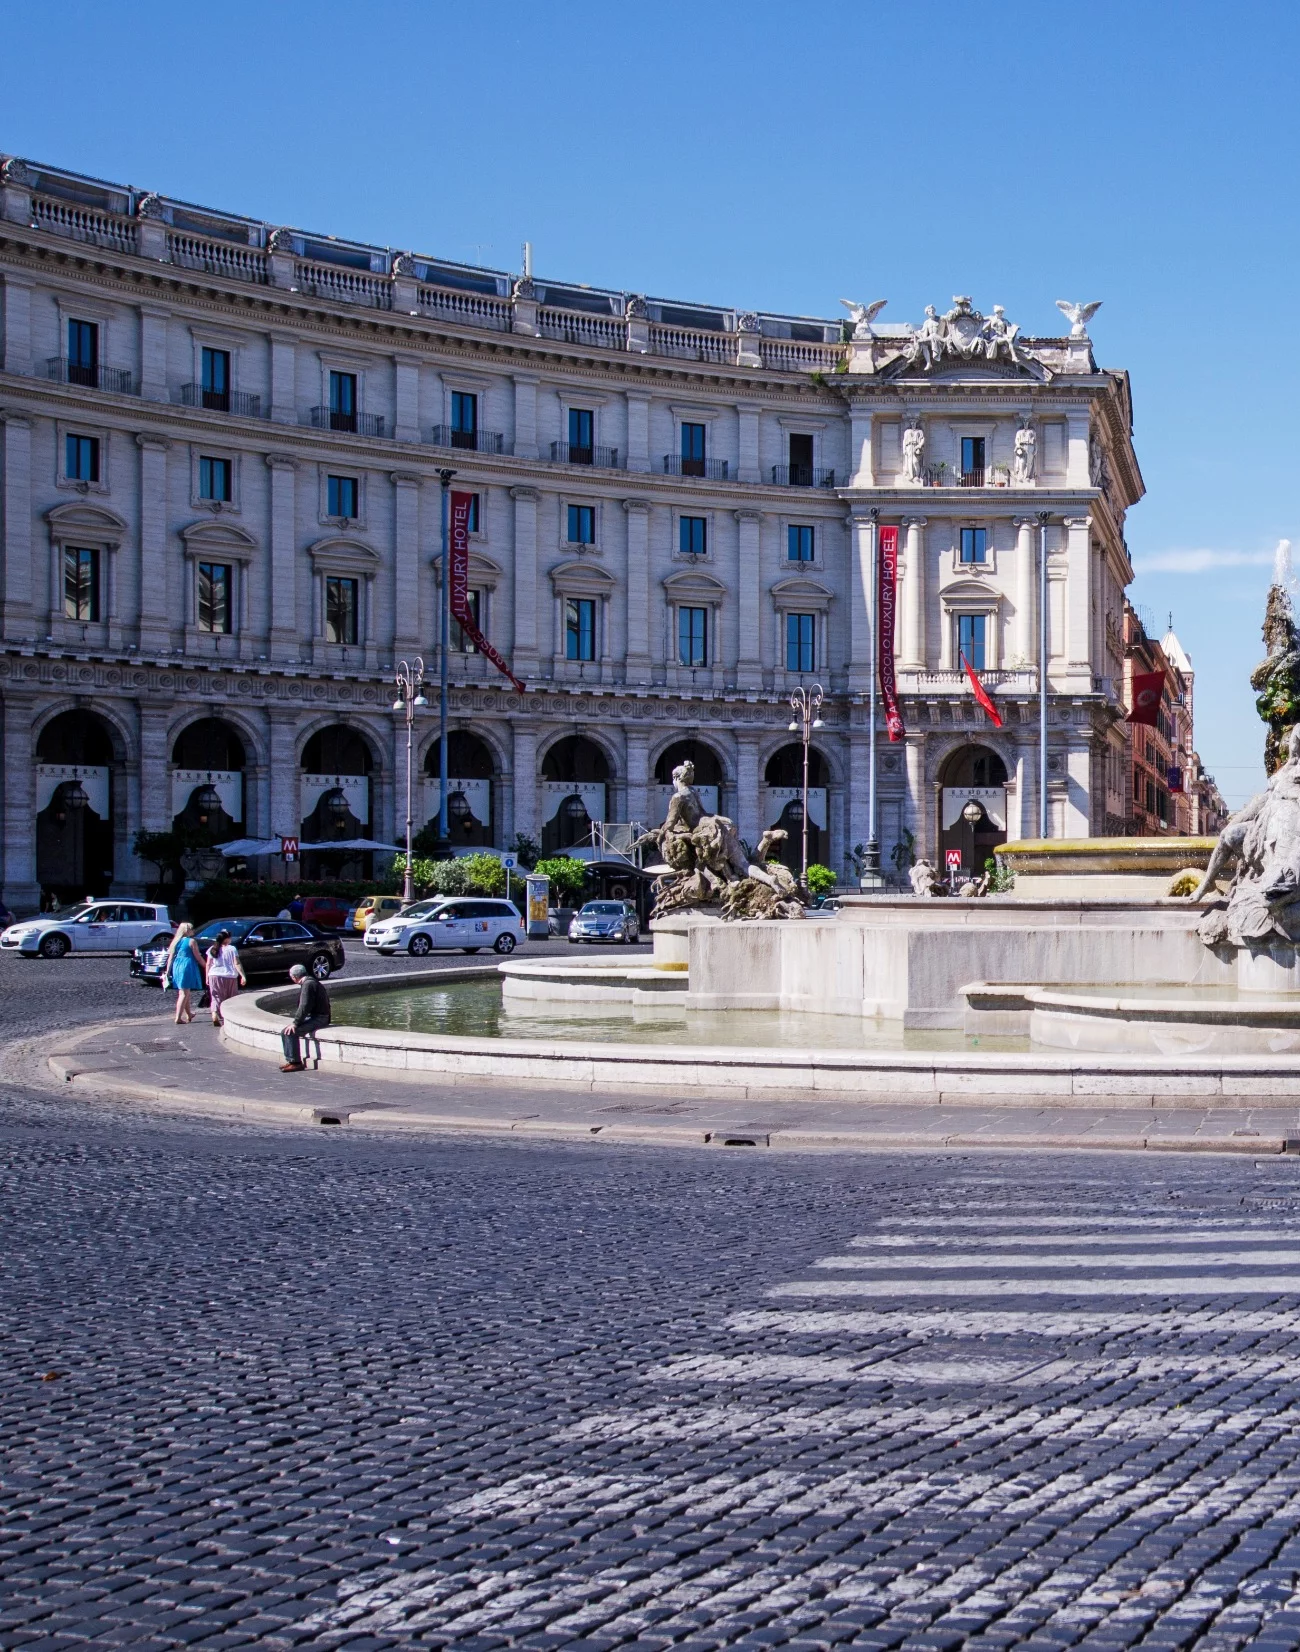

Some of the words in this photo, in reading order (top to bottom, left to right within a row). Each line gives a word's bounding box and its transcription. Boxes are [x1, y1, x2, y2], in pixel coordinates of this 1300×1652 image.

[454, 502, 468, 550] HOTEL
[884, 535, 895, 580] HOTEL
[453, 552, 467, 611] LUXURY
[882, 583, 894, 635] LUXURY
[882, 639, 895, 702] BOSCOLO
[889, 705, 898, 713] A
[40, 767, 98, 775] EXERA
[176, 772, 231, 780] EXERA
[430, 780, 480, 788] EEDRA
[283, 839, 297, 851] M
[947, 852, 960, 862] M
